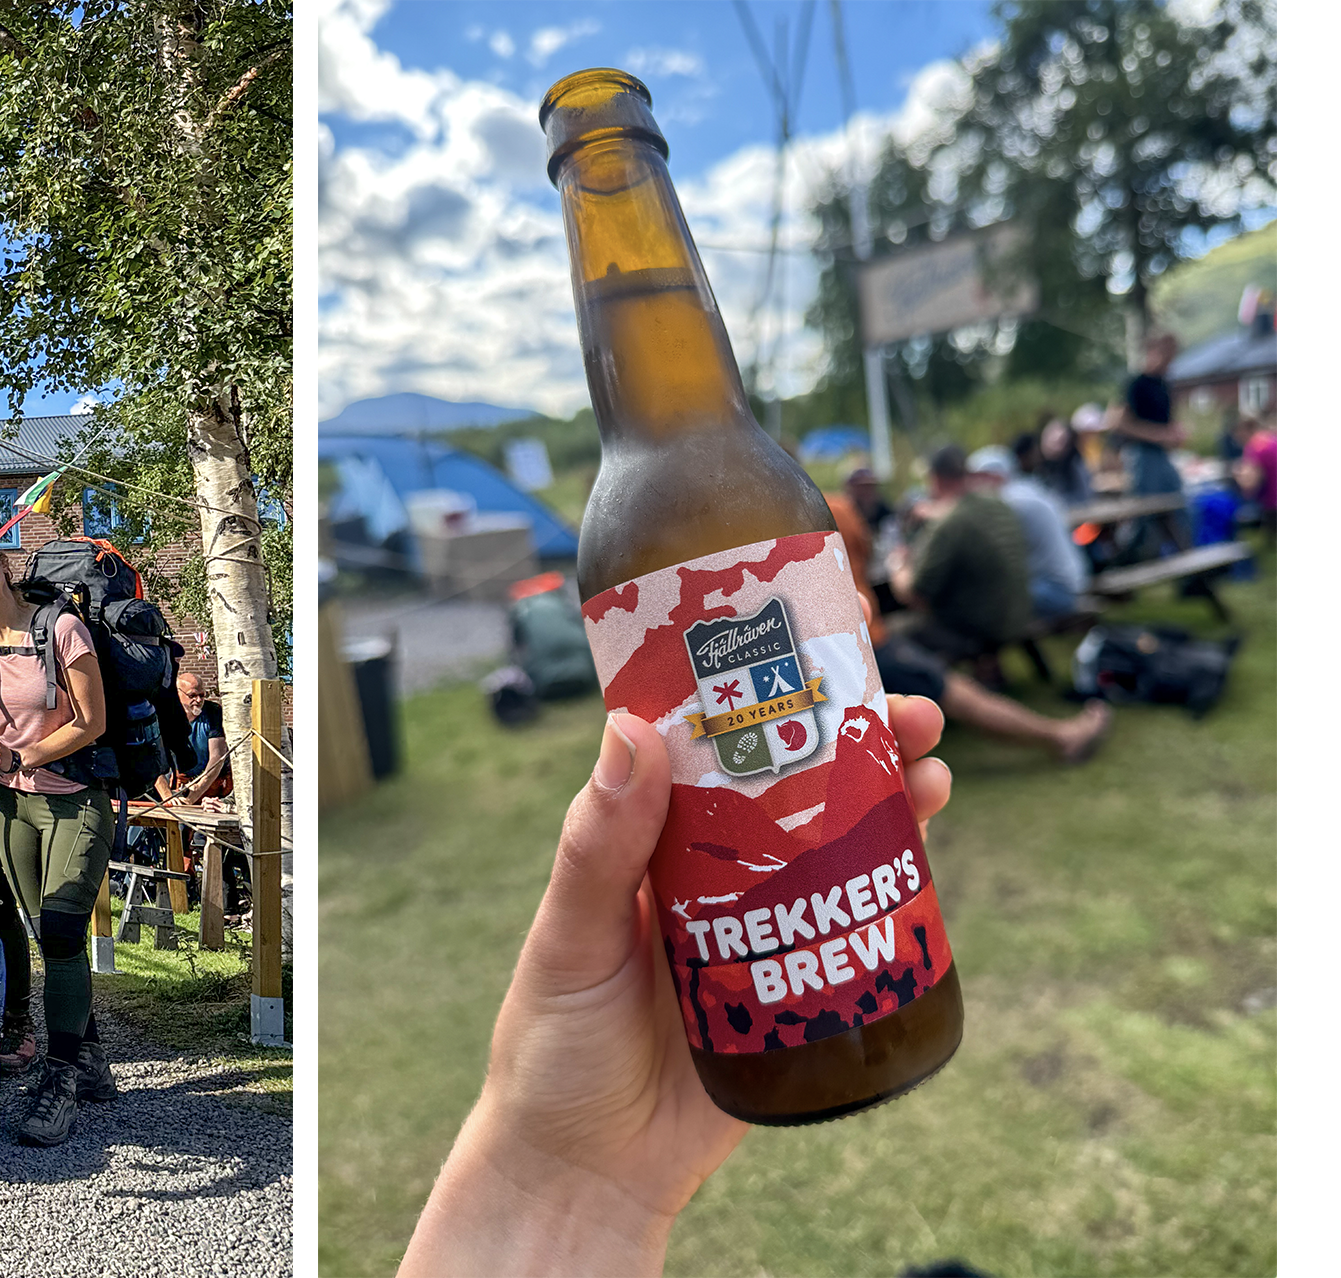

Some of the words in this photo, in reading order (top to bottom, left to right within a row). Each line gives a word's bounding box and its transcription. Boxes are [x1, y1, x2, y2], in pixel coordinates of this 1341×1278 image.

[727, 641, 781, 664] CLASSIC
[727, 713, 745, 727] 20
[749, 699, 795, 721] YEARS
[685, 848, 920, 963] TREKKER'S
[749, 915, 896, 1004] BREW
